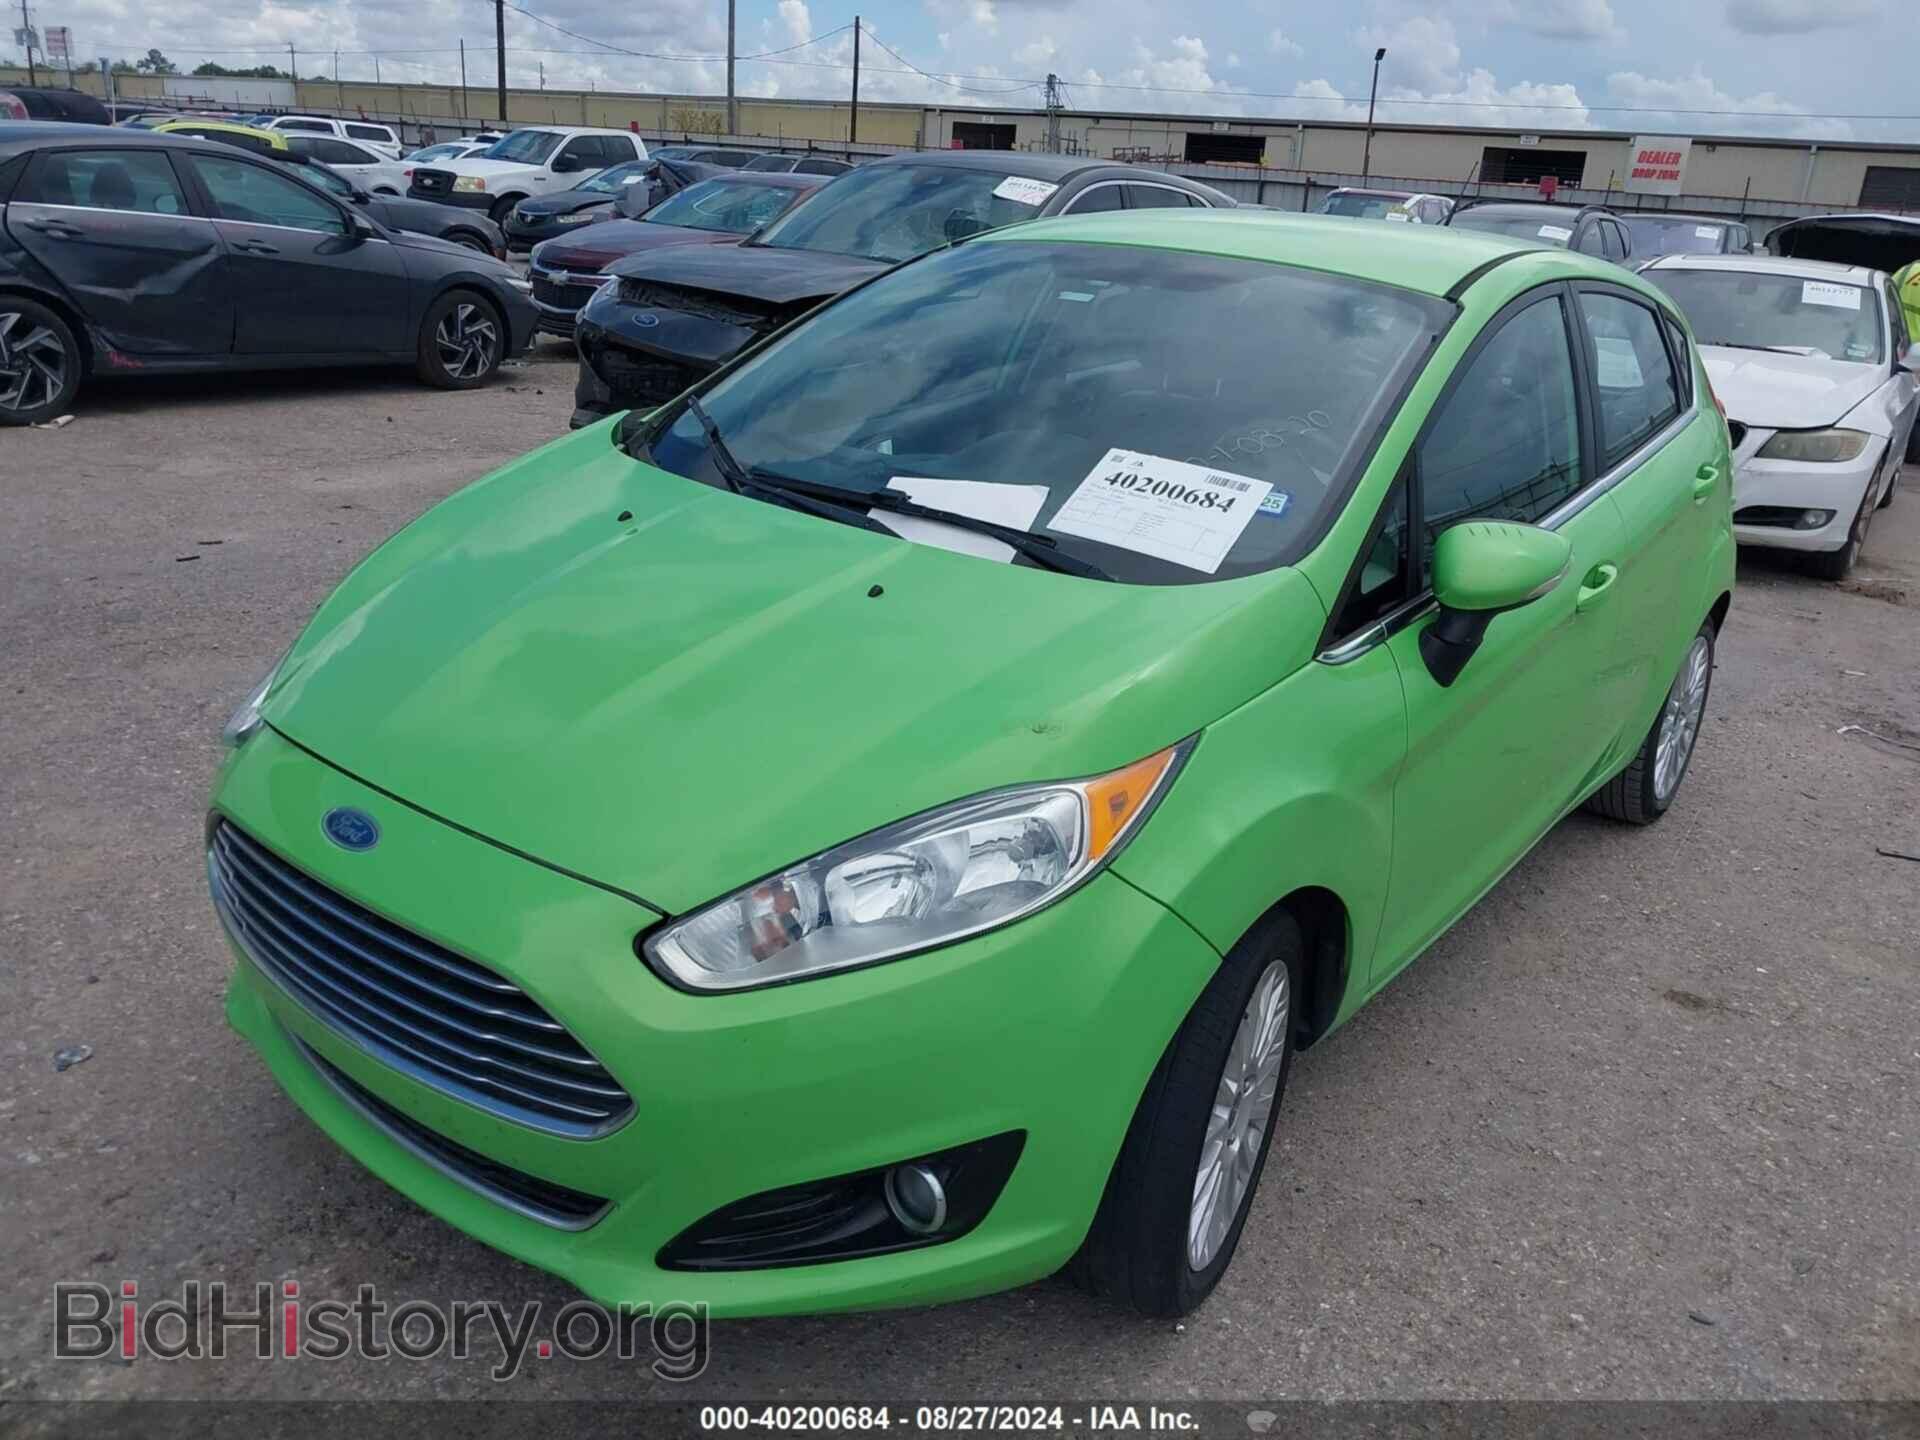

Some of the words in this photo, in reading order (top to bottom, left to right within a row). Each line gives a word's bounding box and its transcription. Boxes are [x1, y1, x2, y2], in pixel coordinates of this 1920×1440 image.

[1637, 150, 1682, 166] DEALER
[1631, 167, 1657, 179] DROP
[1656, 169, 1681, 181] ZONE
[1104, 471, 1236, 514] 40200684
